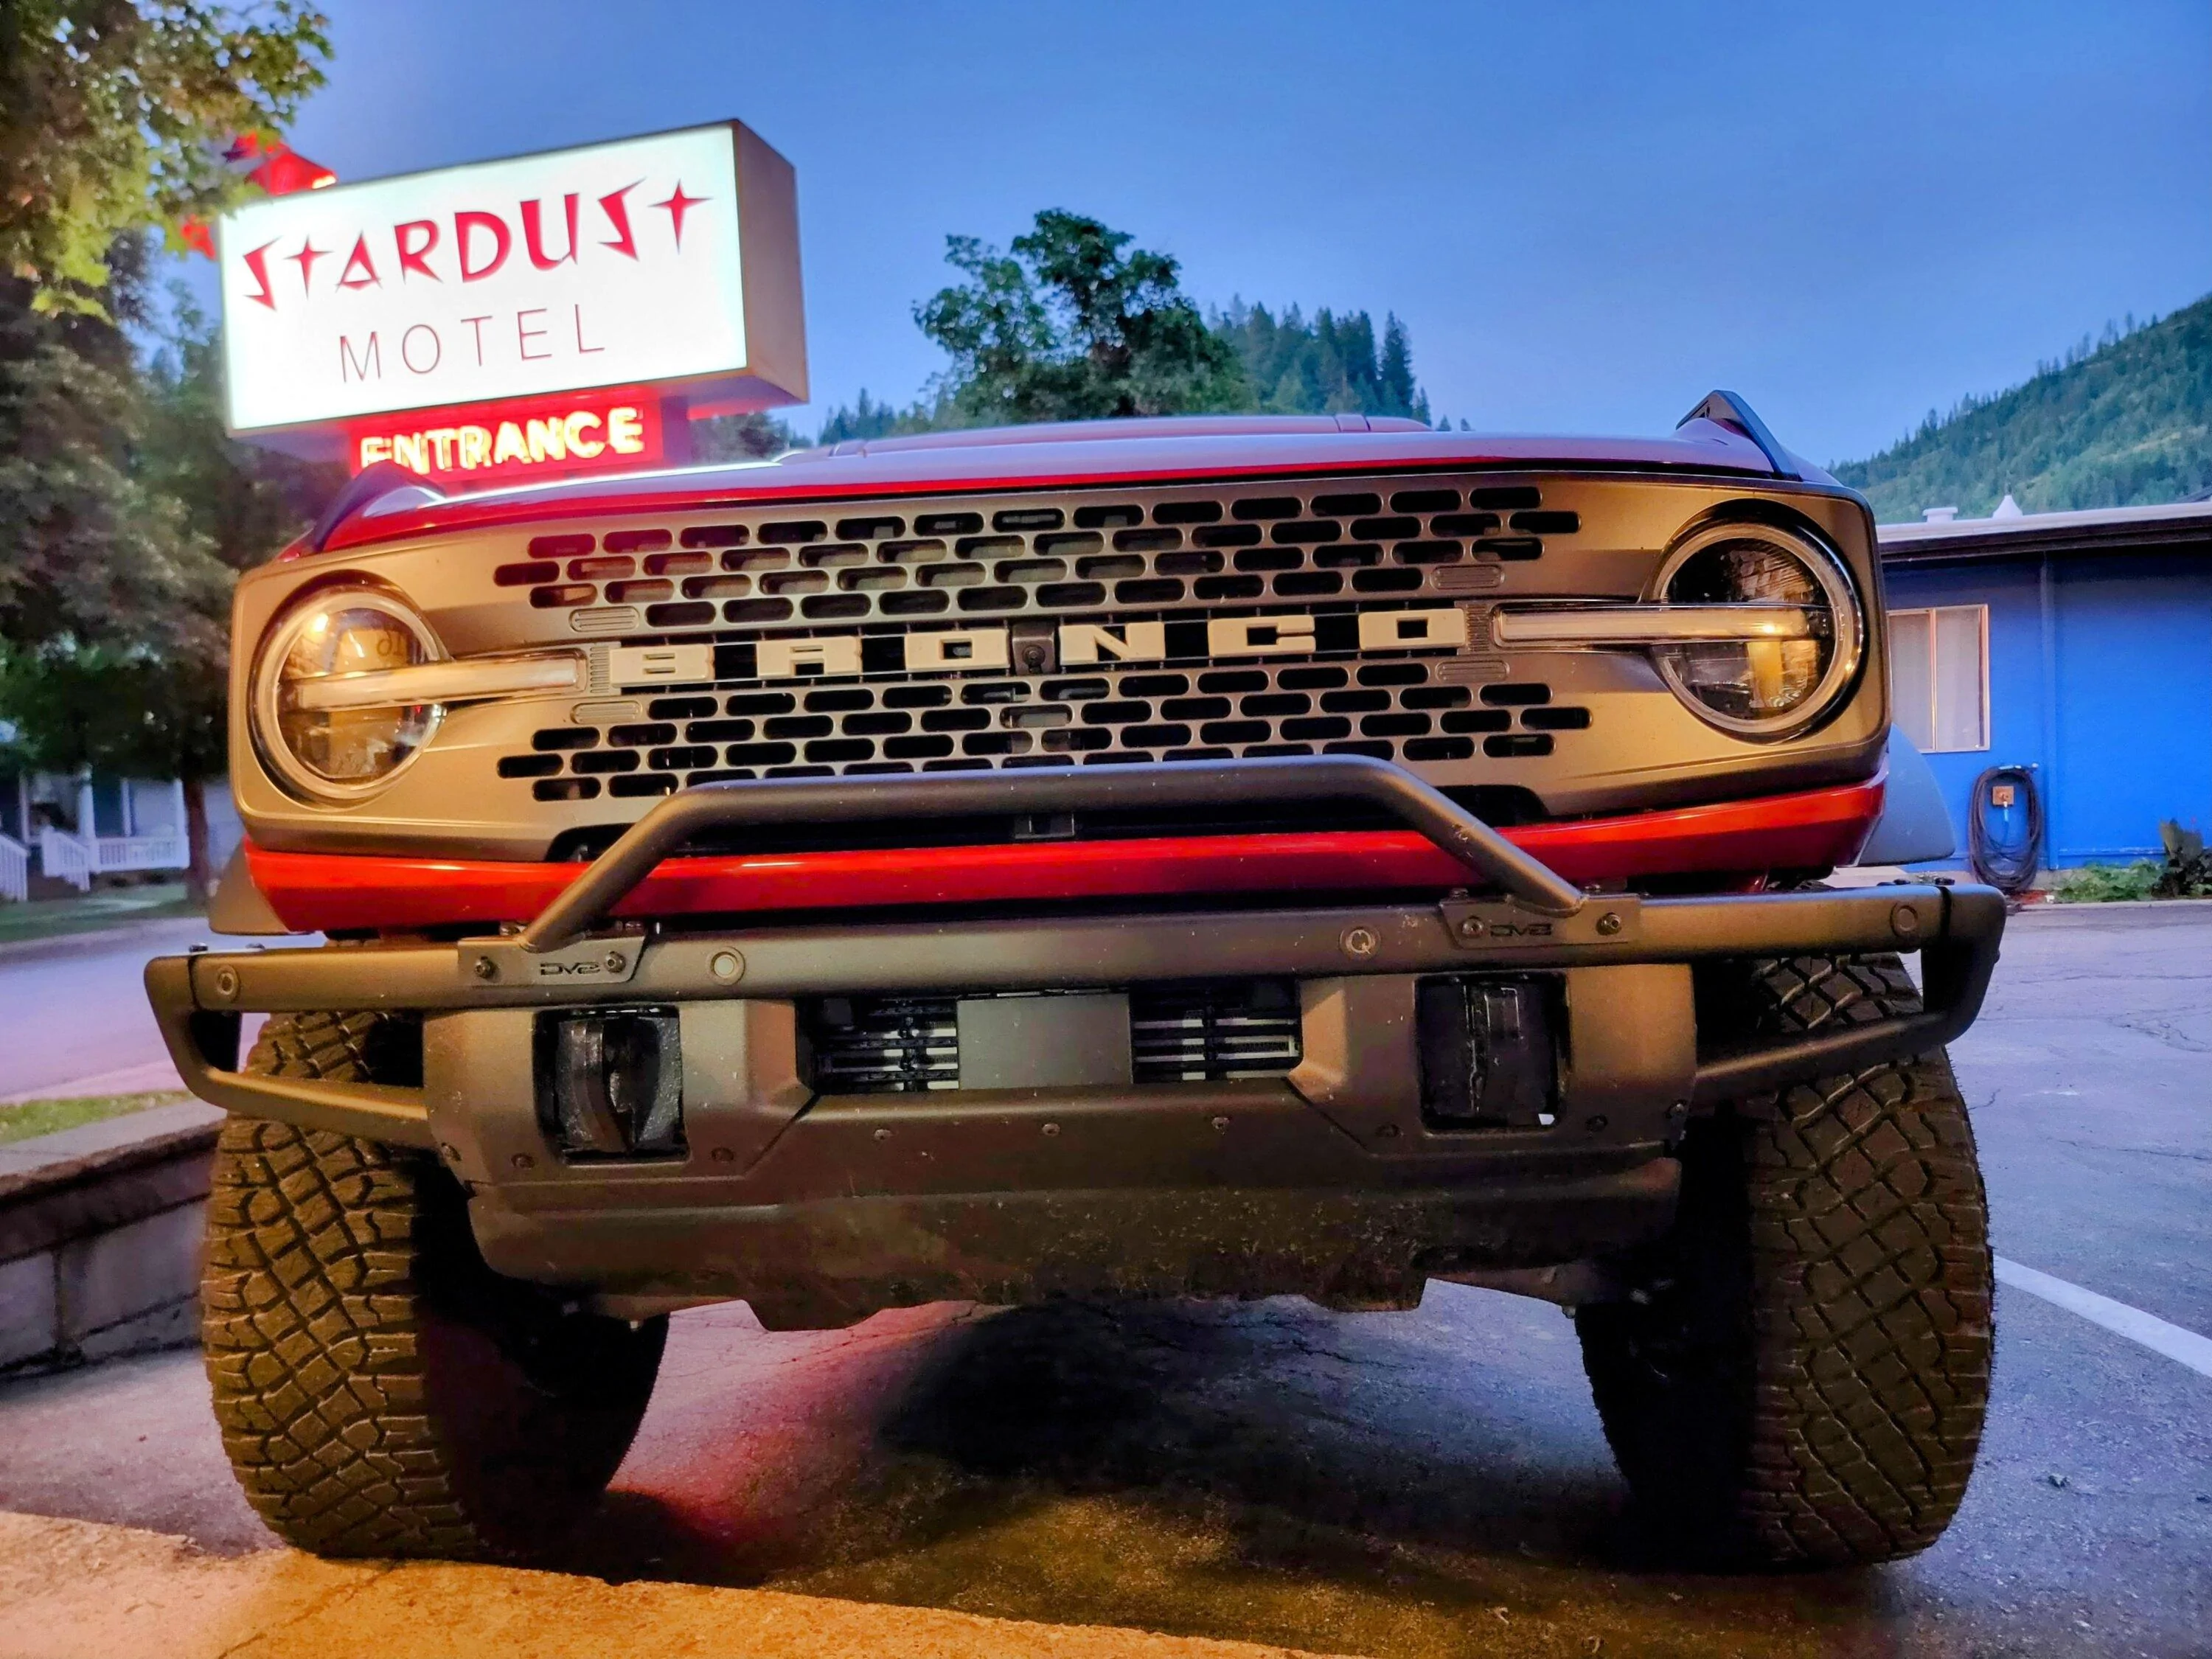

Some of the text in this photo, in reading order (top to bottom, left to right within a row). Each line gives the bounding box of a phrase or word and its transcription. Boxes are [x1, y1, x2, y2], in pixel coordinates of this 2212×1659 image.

[243, 177, 712, 311] STARDUST
[338, 303, 605, 383] MOTEL
[360, 406, 644, 476] ENTRANCE
[609, 608, 1467, 687] BRONCO
